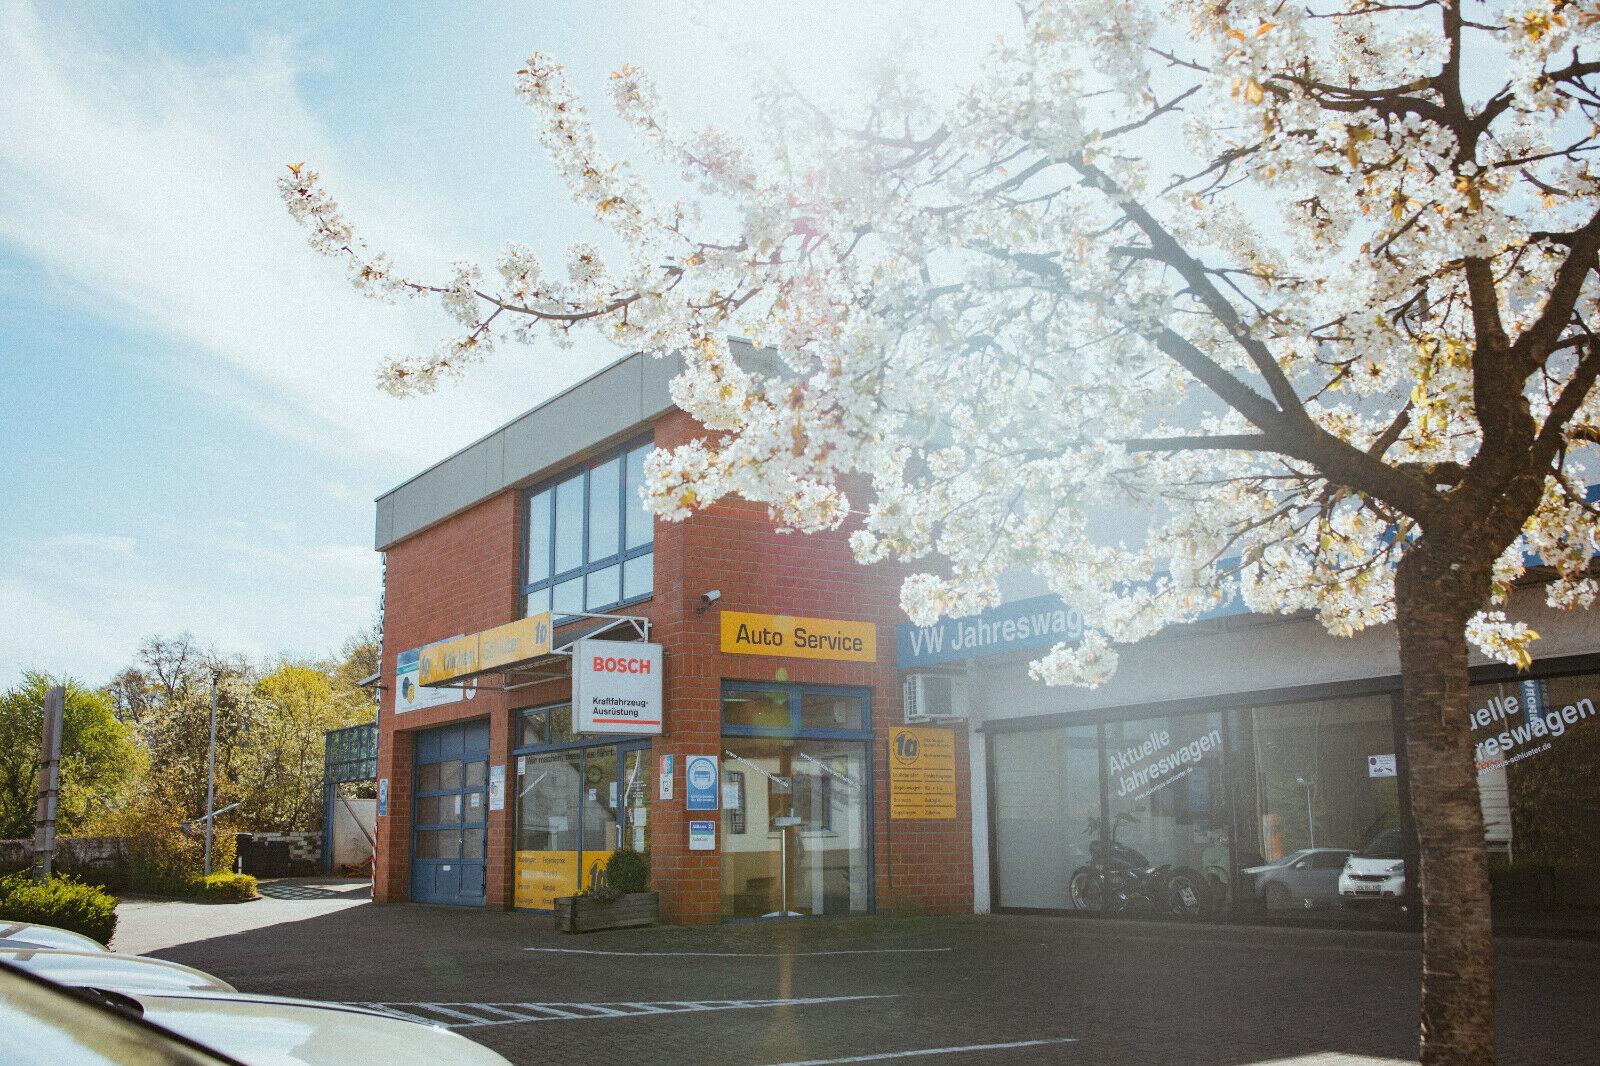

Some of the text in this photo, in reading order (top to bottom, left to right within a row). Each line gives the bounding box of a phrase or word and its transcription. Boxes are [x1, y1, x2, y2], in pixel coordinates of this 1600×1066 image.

[736, 623, 863, 652] Auto Service
[910, 609, 1083, 656] VW Jahreswag
[593, 656, 651, 674] BOSCH
[592, 697, 649, 708] Kraftfahrzeug-
[592, 707, 639, 717] Ausrüstung
[1110, 731, 1170, 776] Aktuelle
[1118, 729, 1222, 797] Jahreswagen
